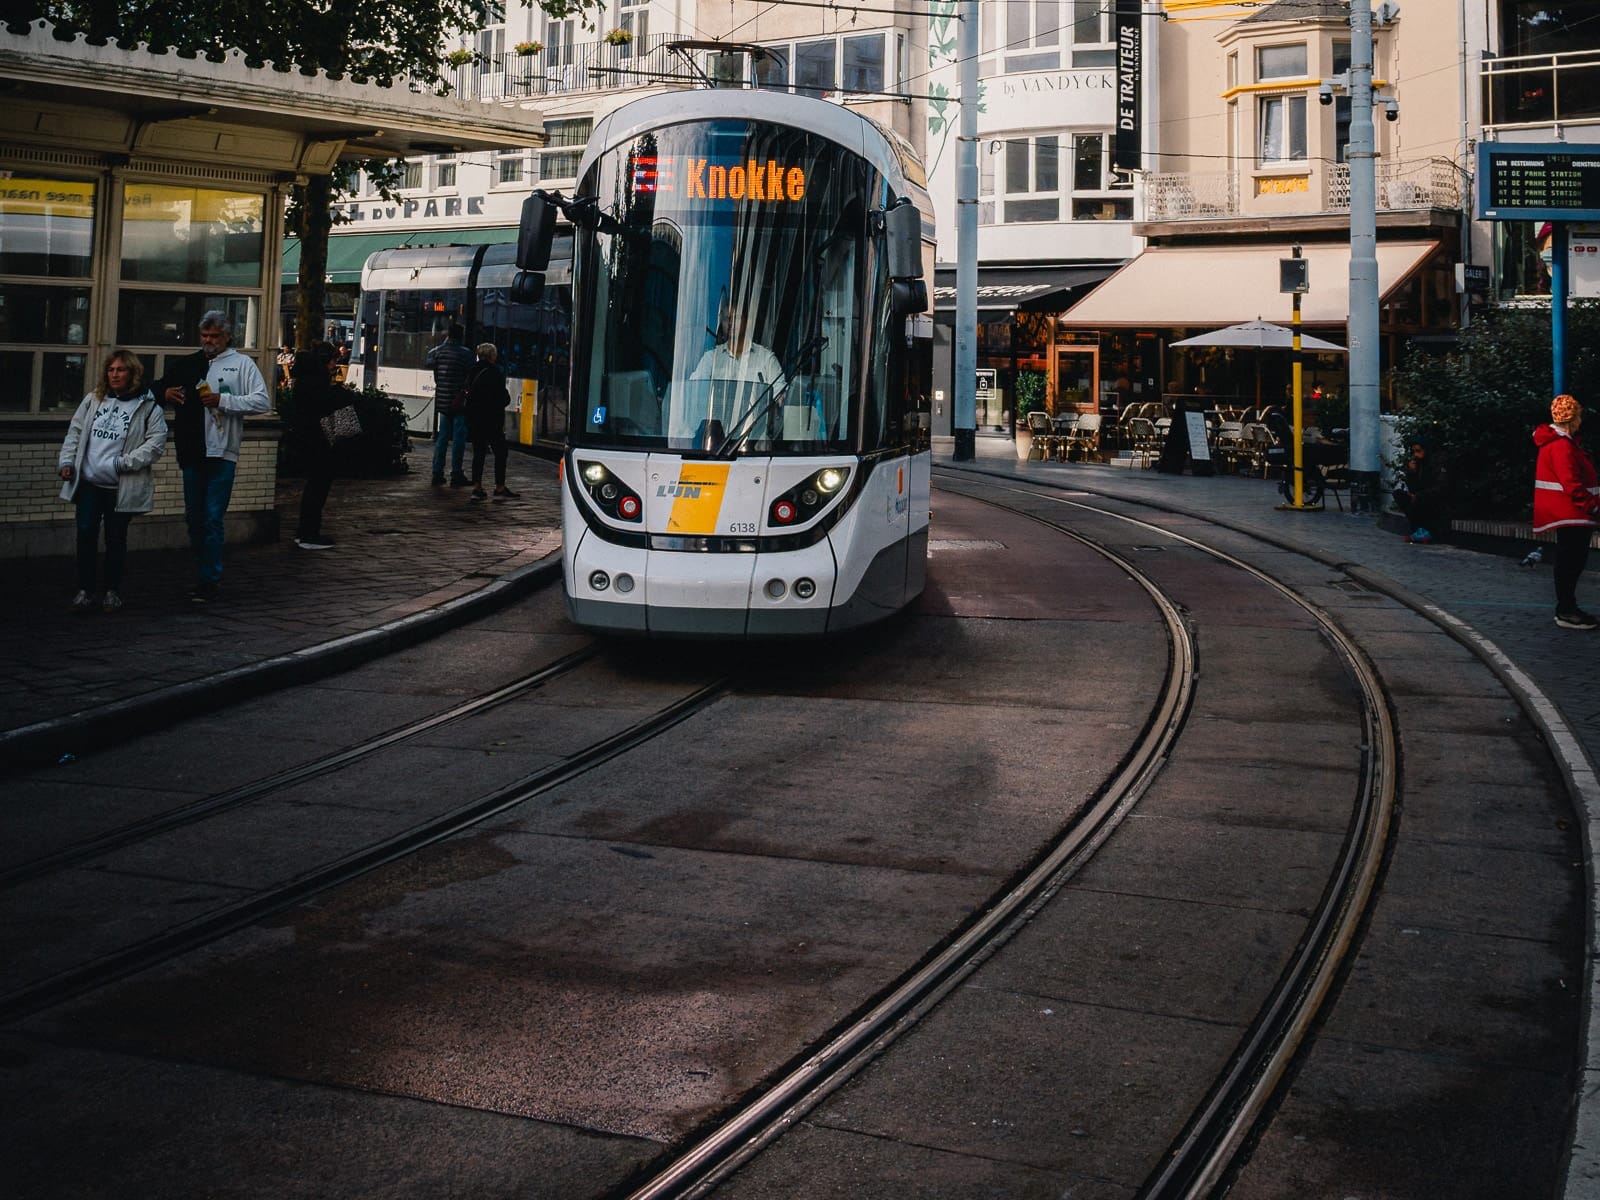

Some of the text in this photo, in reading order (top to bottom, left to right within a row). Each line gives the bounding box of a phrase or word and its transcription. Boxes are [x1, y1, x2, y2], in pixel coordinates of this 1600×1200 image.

[1120, 26, 1135, 131] DE TRAITEUR
[1003, 80, 1016, 98] by
[686, 158, 806, 201] Knokke
[1550, 189, 1582, 197] STATION
[93, 428, 120, 441] TODAY
[730, 522, 756, 533] 6138
